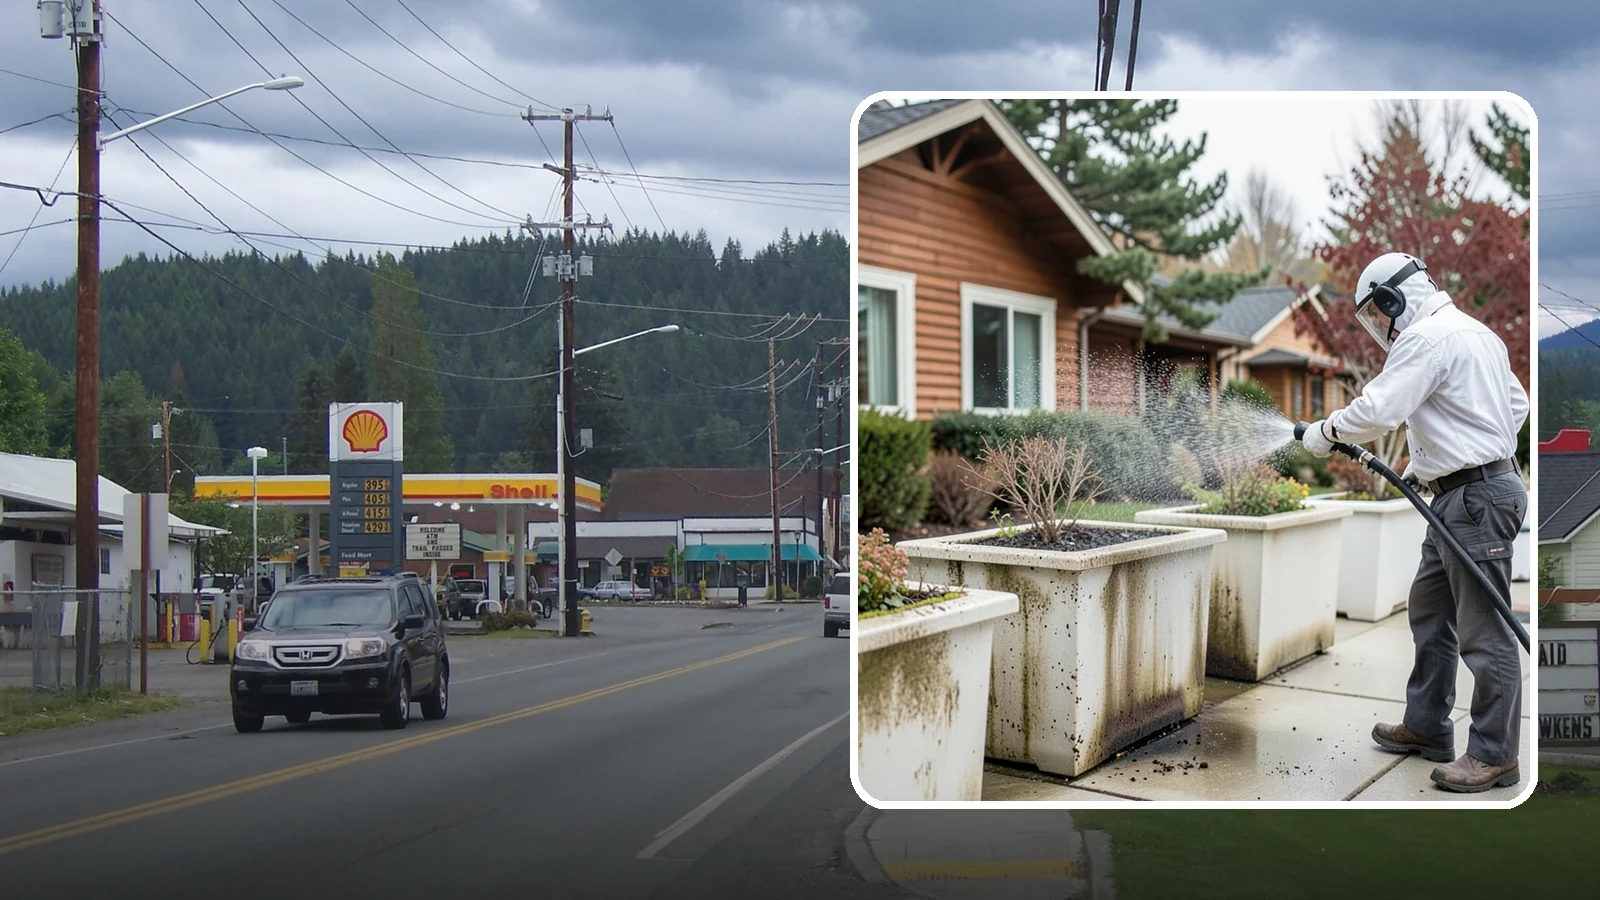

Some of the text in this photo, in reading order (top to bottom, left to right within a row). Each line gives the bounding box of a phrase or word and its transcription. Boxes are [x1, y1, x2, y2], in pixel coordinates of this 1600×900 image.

[365, 480, 384, 490] 395
[490, 484, 547, 499] Shell
[365, 494, 384, 504] 405
[365, 508, 384, 518] 415
[365, 522, 384, 533] 429
[1539, 643, 1567, 665] AID
